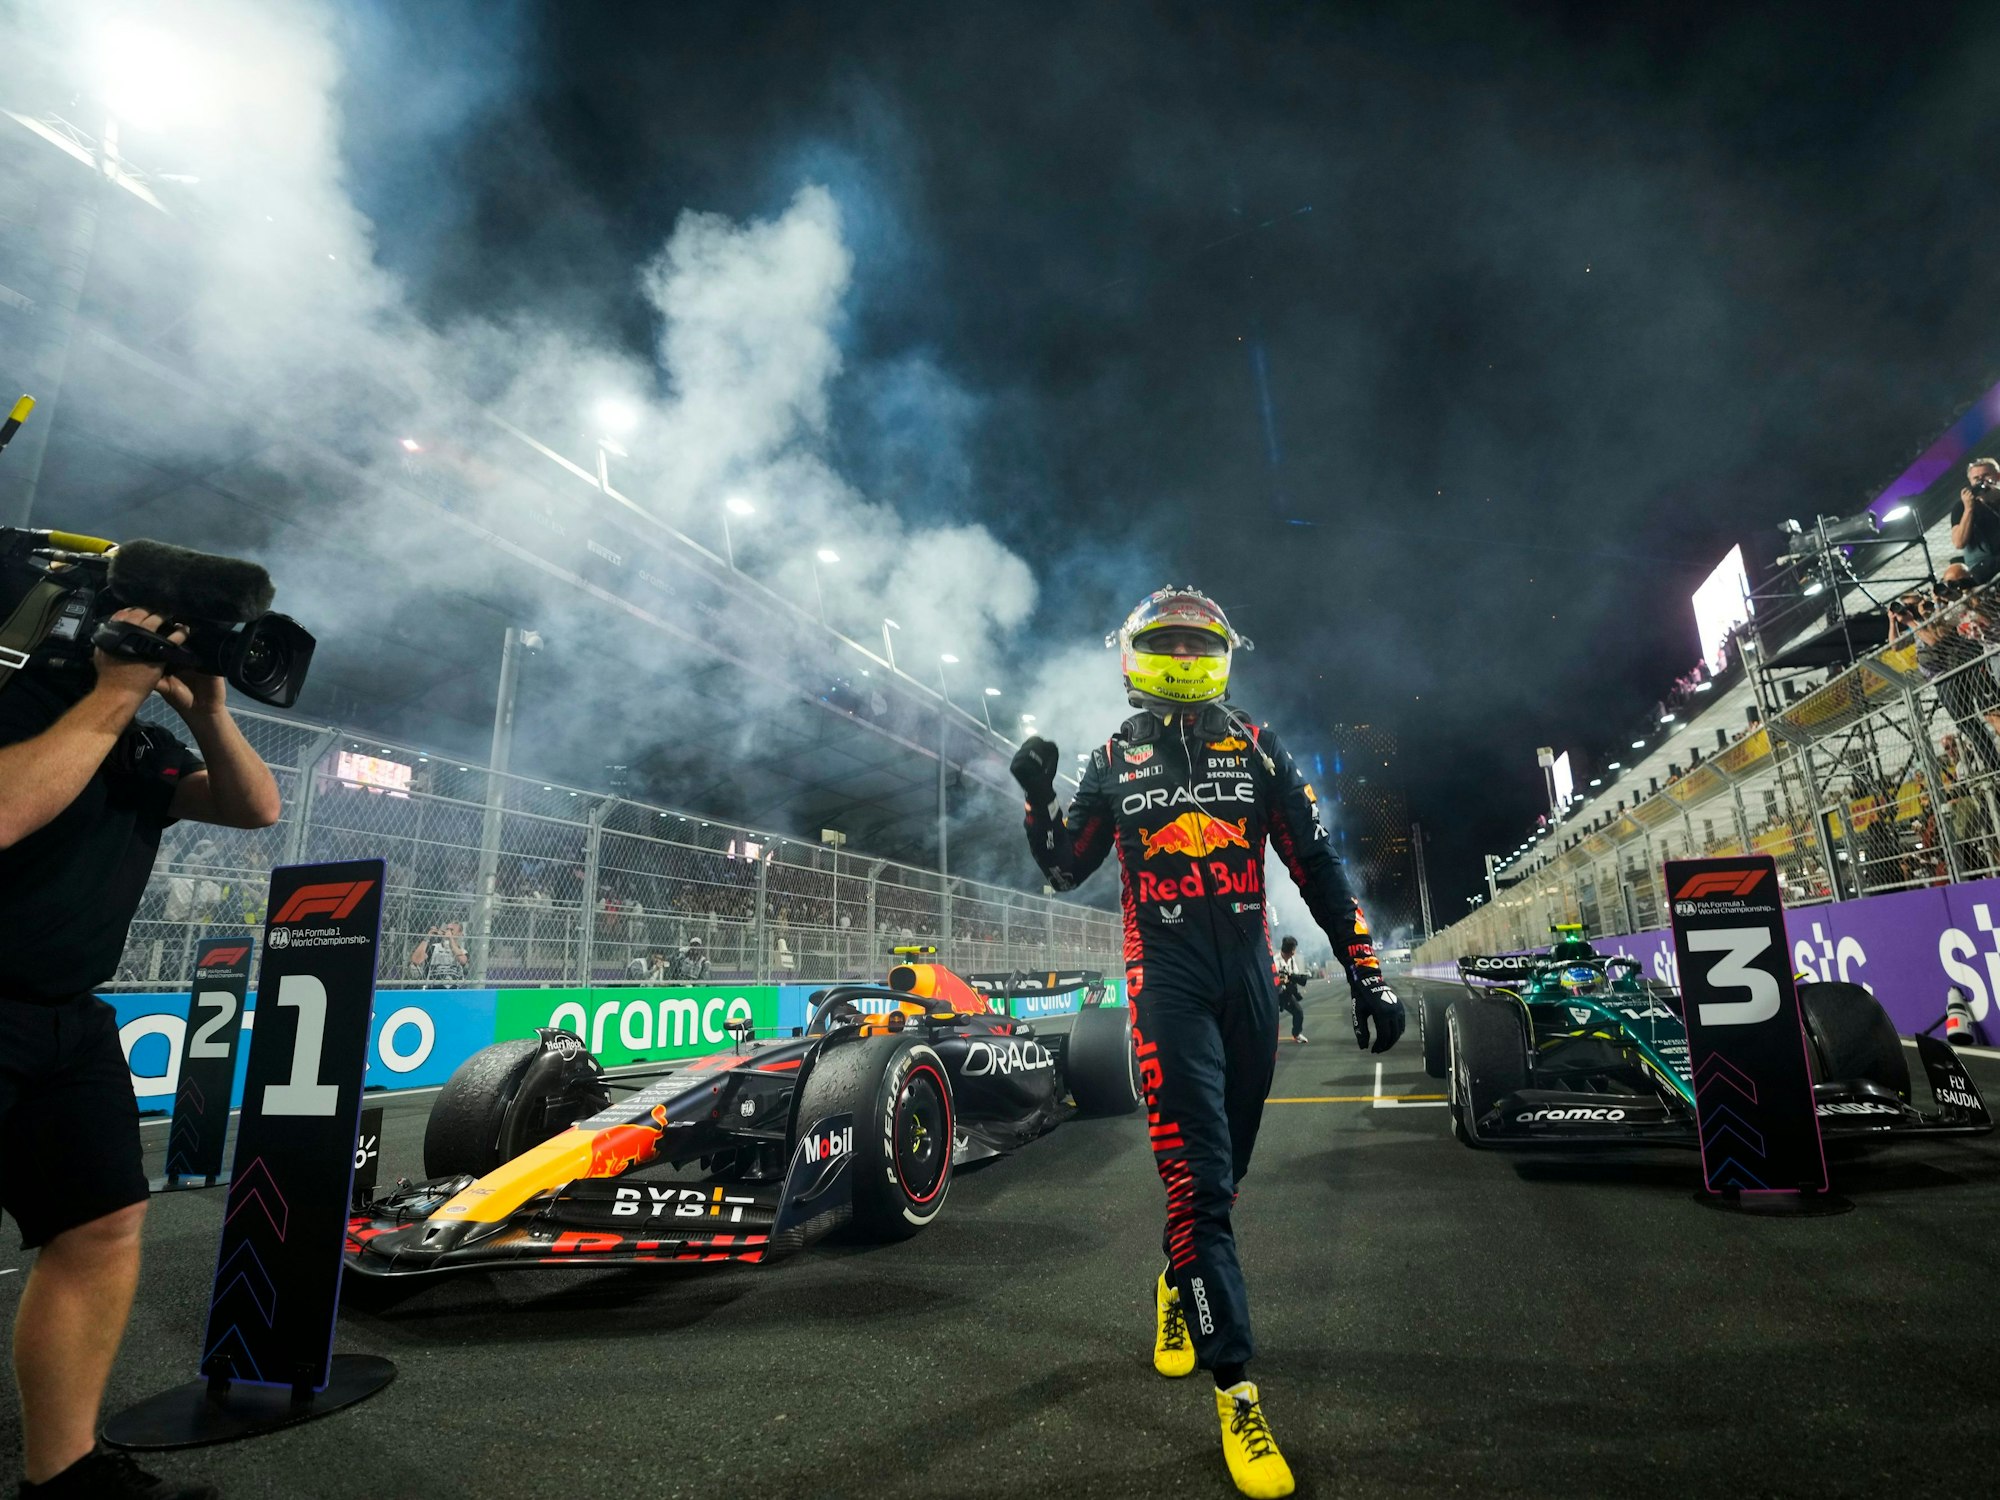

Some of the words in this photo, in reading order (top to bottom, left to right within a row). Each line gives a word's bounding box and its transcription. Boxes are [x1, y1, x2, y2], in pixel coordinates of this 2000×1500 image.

[638, 569, 677, 597] aramco
[1207, 755, 1248, 768] BYBIT
[1118, 767, 1150, 784] Mobil
[1206, 771, 1253, 780] HONDA
[1121, 782, 1255, 815] ORACLE
[1138, 862, 1205, 903] Red
[1209, 858, 1259, 896] Bull
[1242, 903, 1261, 911] CHECO
[1698, 907, 1720, 915] World
[1710, 900, 1741, 908] Formula
[1741, 899, 1746, 907] 1
[291, 930, 304, 938] FIA
[305, 927, 336, 938] Formula
[336, 926, 341, 936] 1
[291, 938, 313, 948] World
[1686, 926, 1781, 1027] 3
[1620, 1007, 1671, 1020] 14
[189, 991, 238, 1058] 2
[548, 997, 752, 1055] aramco
[261, 975, 339, 1116] 1
[545, 1039, 565, 1051] Hard
[565, 1038, 583, 1050] Rock
[1949, 1074, 1965, 1090] FLY
[1942, 1088, 1981, 1111] SAUDIA
[884, 1077, 900, 1160] ZERO
[1516, 1108, 1626, 1122] aramco
[803, 1126, 853, 1164] Mobil
[886, 1167, 898, 1184] P
[611, 1187, 755, 1223] BYBIT
[1191, 1277, 1215, 1335] sparco
